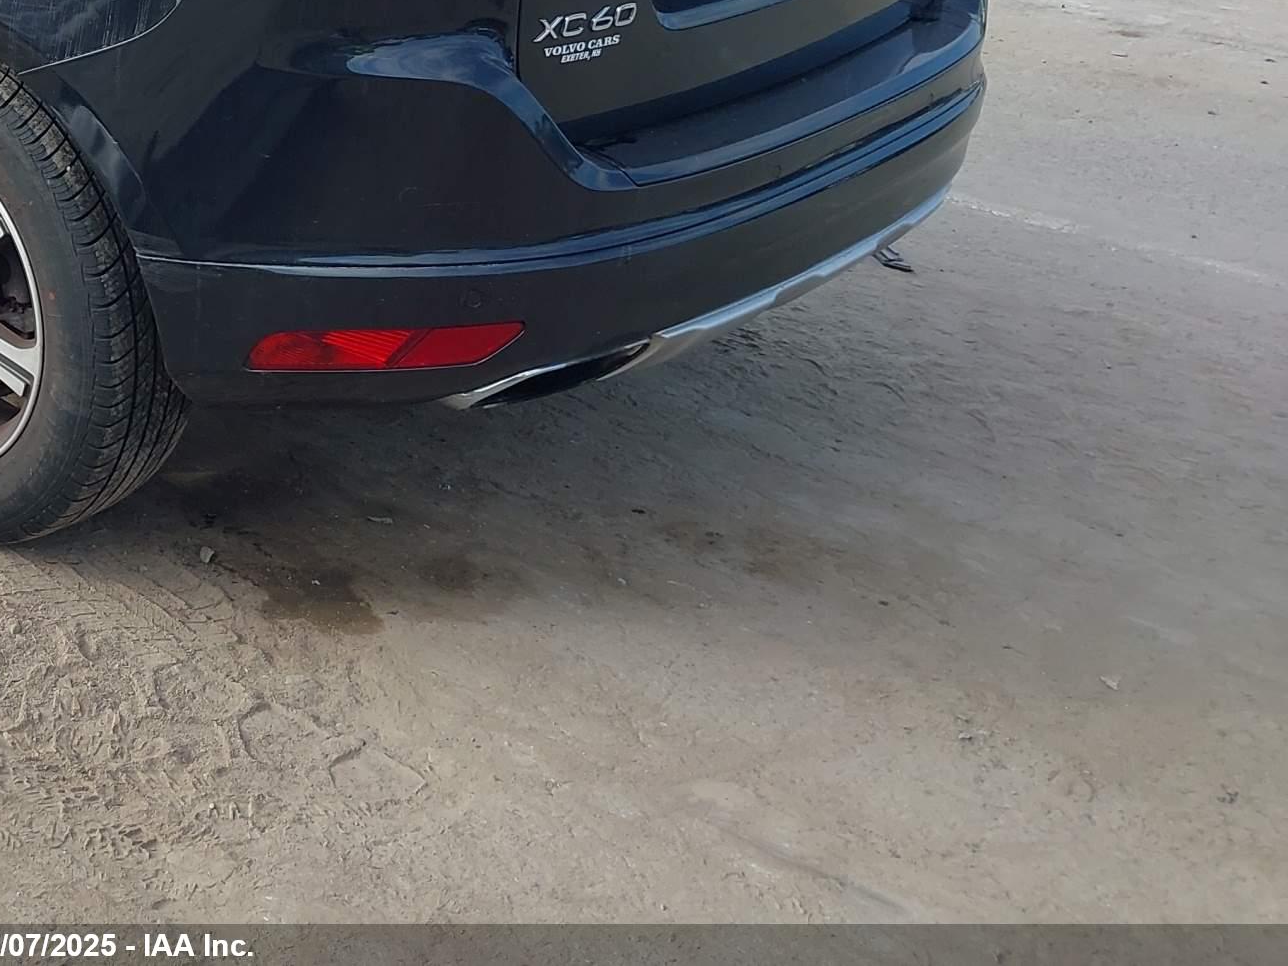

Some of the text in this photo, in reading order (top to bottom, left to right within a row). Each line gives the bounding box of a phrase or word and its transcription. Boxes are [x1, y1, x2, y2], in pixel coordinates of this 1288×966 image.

[533, 2, 637, 43] XC60
[544, 34, 621, 57] VOLVO CARS
